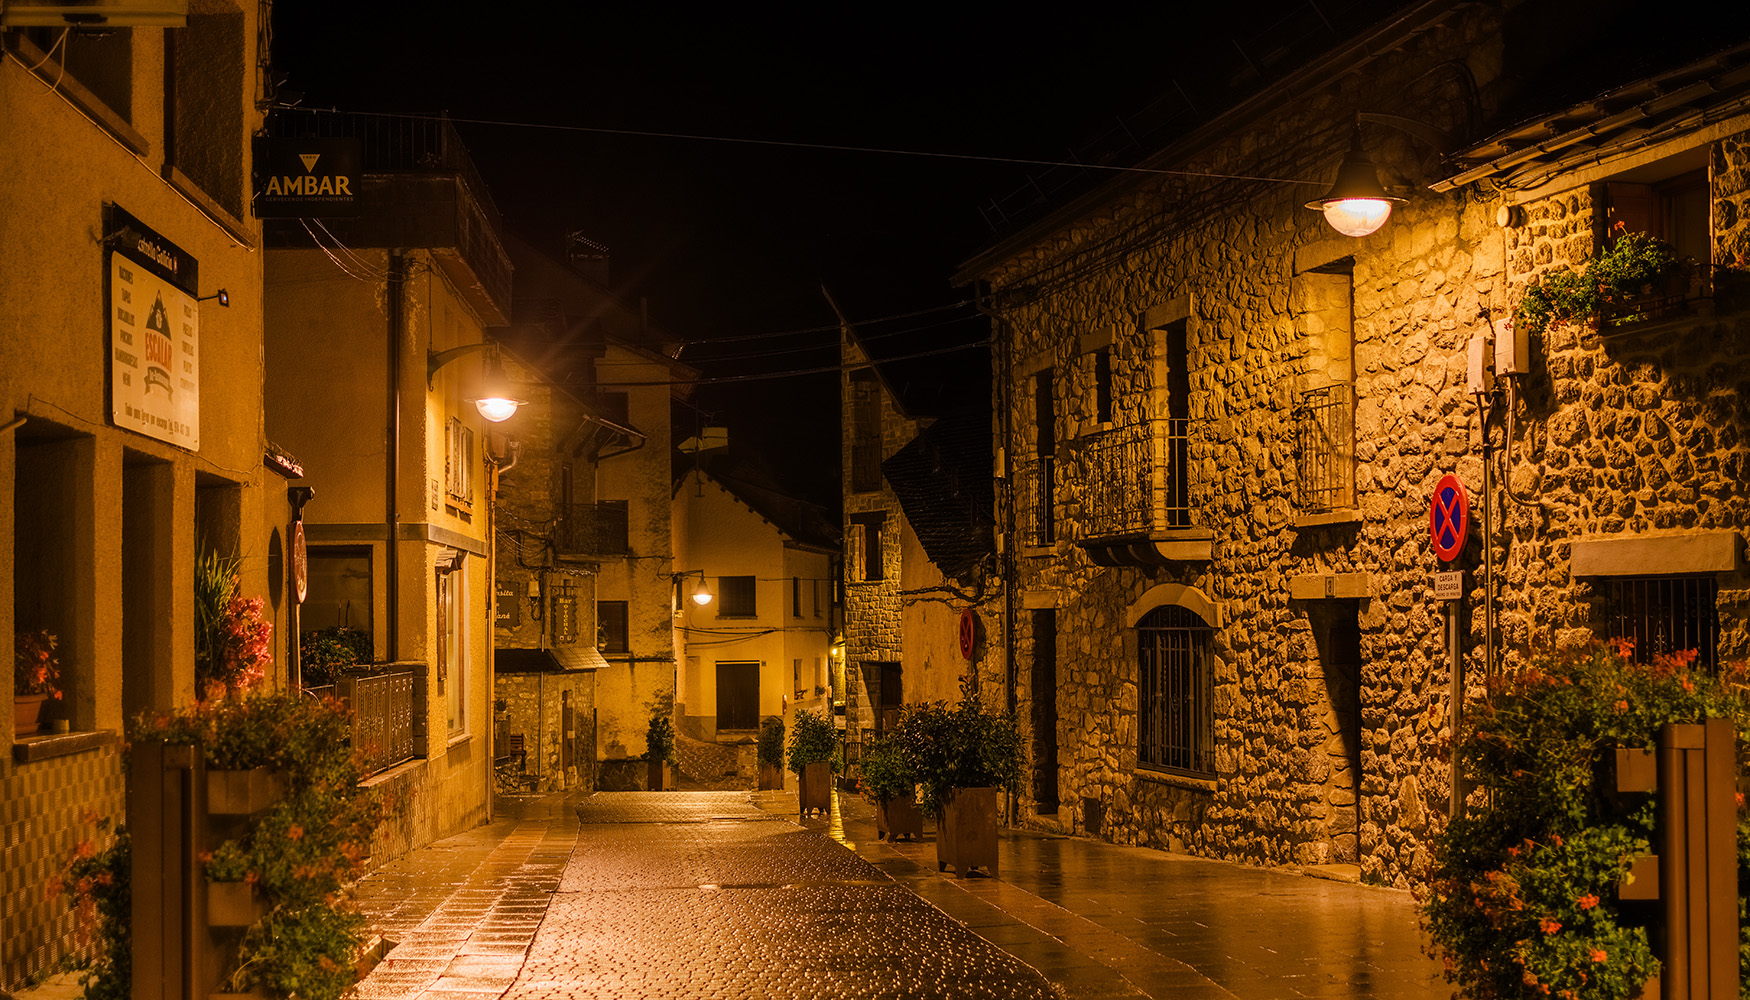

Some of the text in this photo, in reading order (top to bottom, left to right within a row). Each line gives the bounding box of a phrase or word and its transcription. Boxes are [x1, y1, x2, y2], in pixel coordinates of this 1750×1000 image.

[265, 175, 353, 196] AMBAR
[144, 331, 173, 374] ESCALAR
[1437, 583, 1459, 591] DESCARGA
